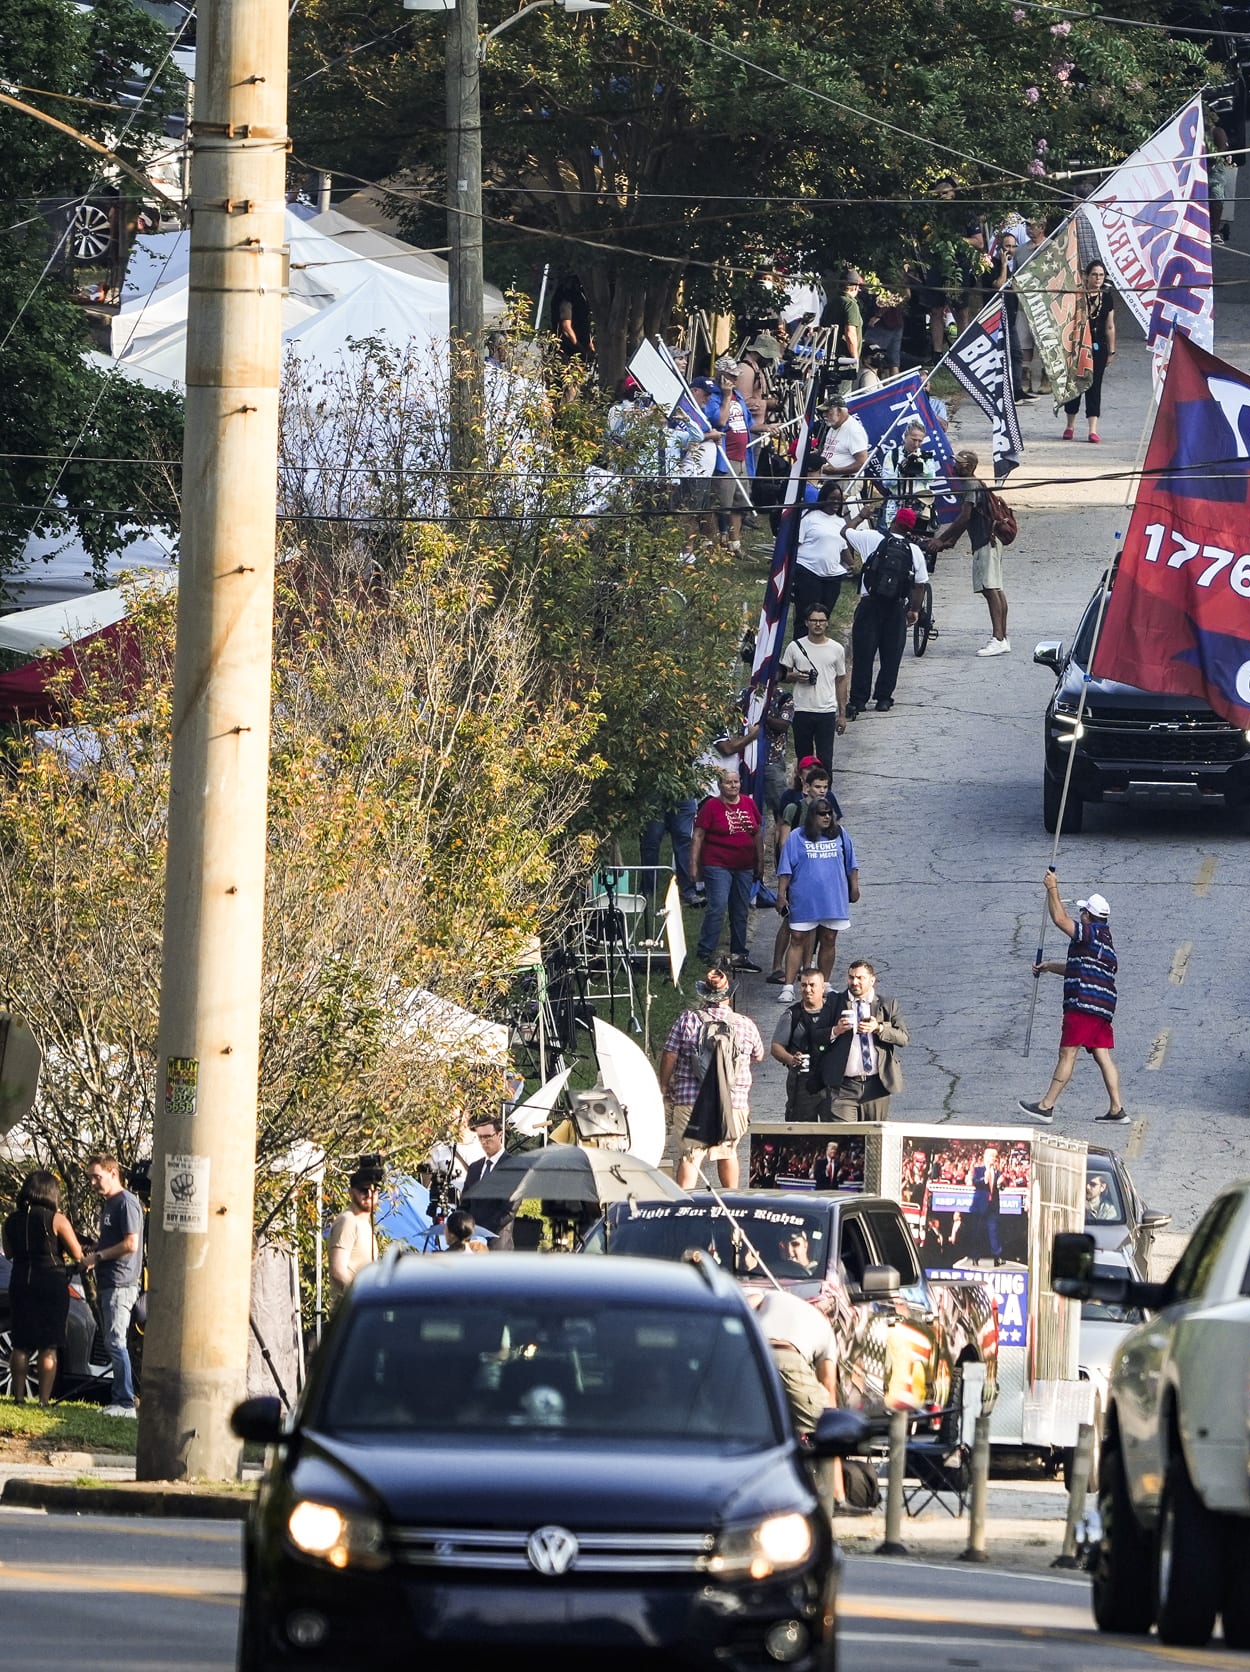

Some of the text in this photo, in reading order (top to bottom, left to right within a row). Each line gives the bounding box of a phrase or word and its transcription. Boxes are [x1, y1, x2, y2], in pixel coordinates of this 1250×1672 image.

[805, 842, 837, 850] DEFUND
[806, 851, 818, 859] THE
[180, 1060, 199, 1071] BUY
[674, 1206, 708, 1217] For
[753, 1208, 805, 1226] Rights
